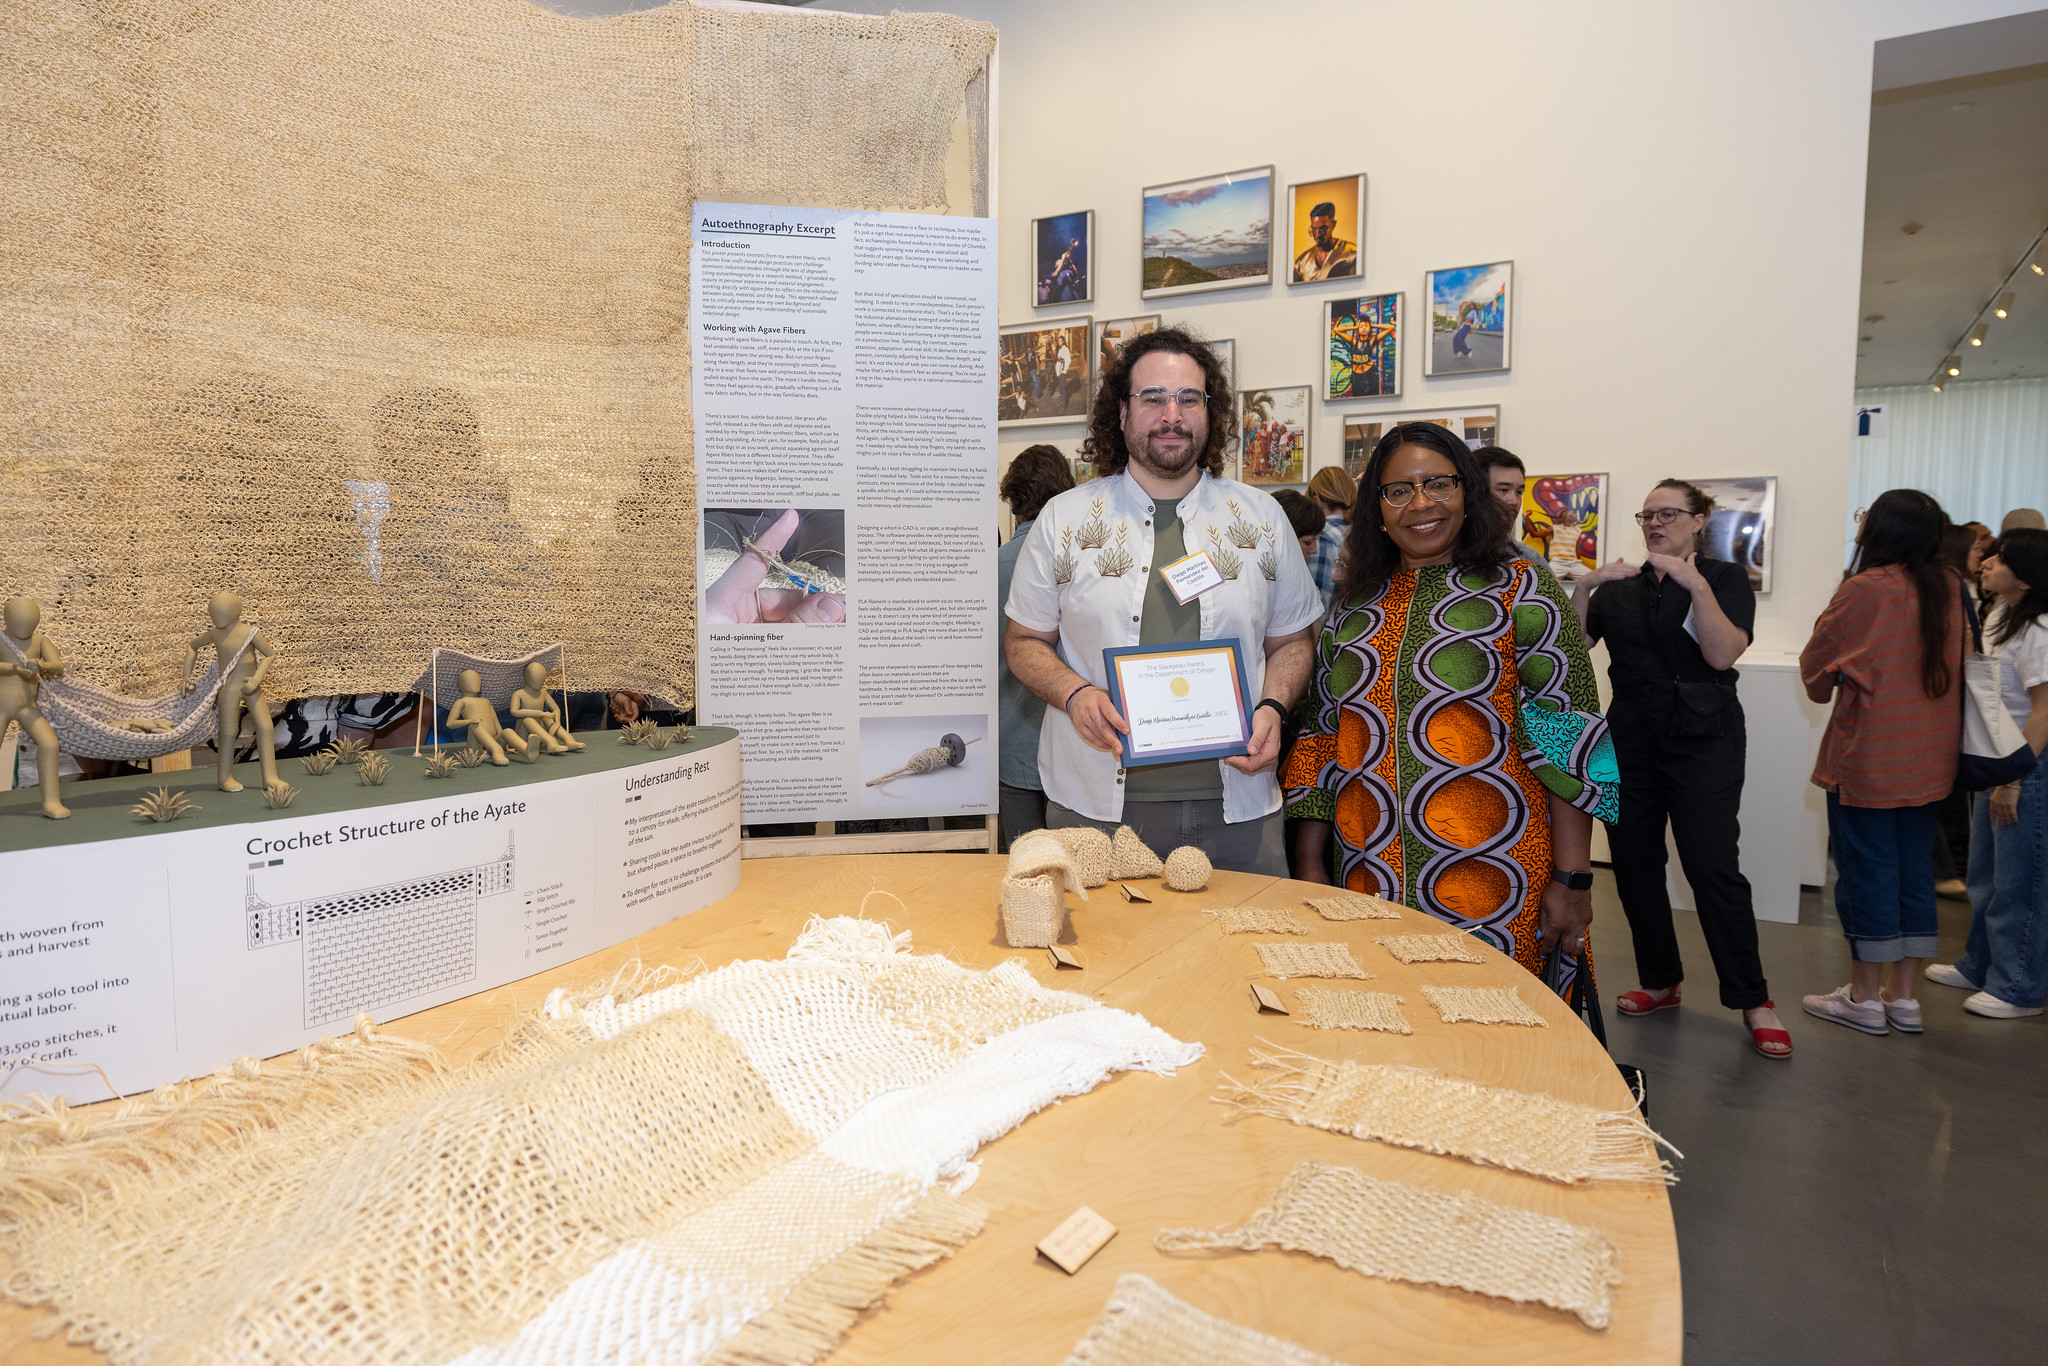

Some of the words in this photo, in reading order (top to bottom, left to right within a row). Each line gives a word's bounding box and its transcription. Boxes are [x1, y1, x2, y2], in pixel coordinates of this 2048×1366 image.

[702, 218, 793, 234] Autoethnography
[797, 223, 835, 236] Excerpt
[702, 240, 750, 249] Introduction
[703, 324, 736, 333] Working
[758, 326, 780, 335] Agave
[710, 634, 765, 642] Hand-spinning
[626, 766, 692, 791] Understanding
[694, 761, 709, 774] Rest
[629, 818, 637, 826] My
[638, 809, 671, 823] interpretation
[686, 802, 697, 810] ayate
[698, 795, 716, 805] transforms
[247, 831, 332, 855] Crochet
[339, 819, 425, 842] Structure
[431, 809, 450, 827] of
[453, 808, 479, 824] the
[484, 802, 526, 821] Ayate
[640, 823, 657, 833] canopy
[666, 816, 680, 825] shade,
[681, 811, 697, 820] offering
[698, 807, 709, 815] shade
[637, 862, 653, 874] shared
[654, 860, 669, 870] pause,
[674, 853, 686, 862] space
[693, 845, 708, 855] breathe
[626, 899, 638, 908] with
[639, 893, 655, 903] worth.
[656, 889, 666, 897] Rest
[672, 879, 695, 891] resistance.
[537, 906, 550, 914] Single
[551, 901, 568, 910] Crochet
[536, 919, 550, 927] Single
[551, 914, 567, 923] Crochet
[20, 926, 66, 939] woven
[72, 921, 103, 932] from
[8, 944, 33, 957] and
[39, 937, 89, 952] harvest
[536, 945, 551, 953] Woven
[38, 987, 66, 1000] solo
[71, 980, 98, 994] tool
[103, 978, 129, 989] into
[37, 1003, 76, 1016] labor.
[45, 1029, 103, 1045] stitches,
[108, 1024, 117, 1034] it
[21, 1053, 36, 1065] of
[40, 1047, 77, 1061] craft.
